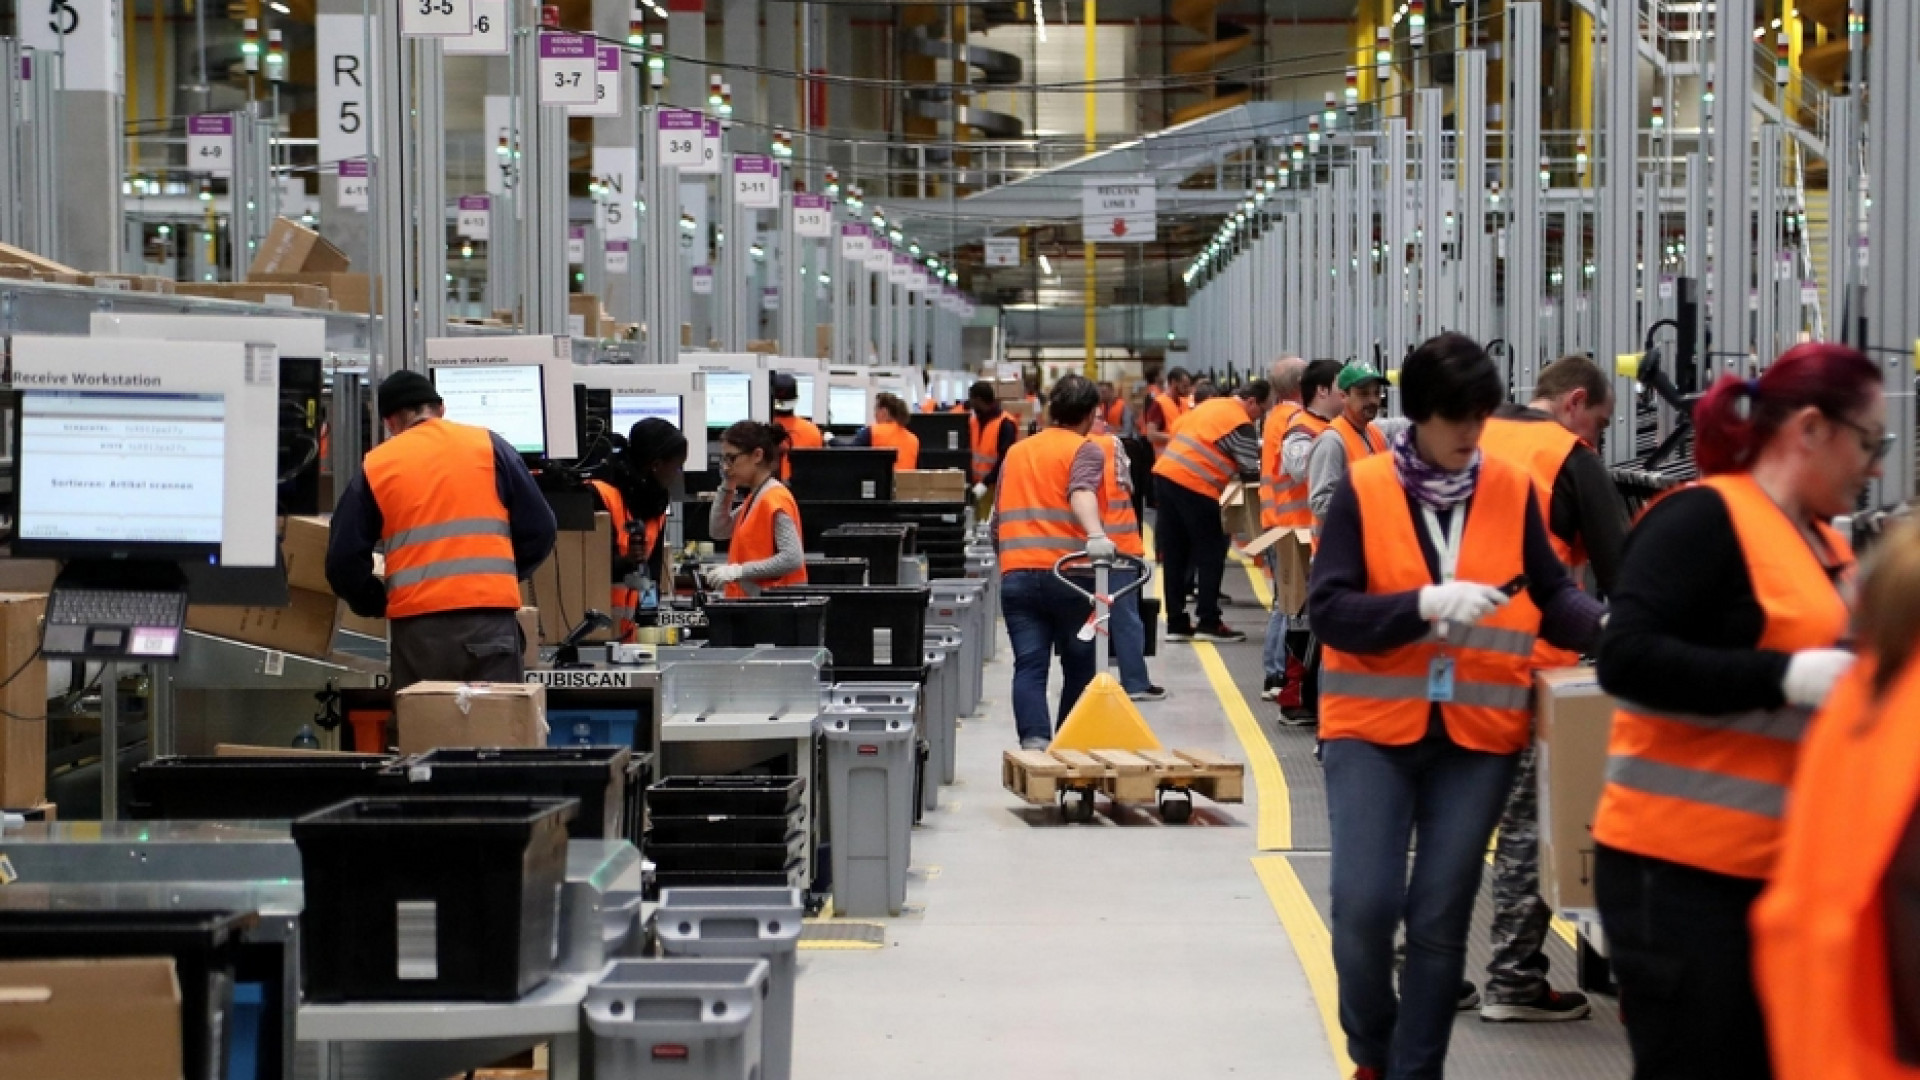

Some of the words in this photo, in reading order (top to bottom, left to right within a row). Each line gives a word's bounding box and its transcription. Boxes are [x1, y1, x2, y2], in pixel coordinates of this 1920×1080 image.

[334, 55, 363, 87] R
[554, 72, 583, 87] 3-7
[340, 102, 361, 133] 5
[670, 139, 692, 153] 3-9
[740, 182, 765, 192] 3-11
[607, 203, 622, 224] 5
[13, 371, 68, 385] Receive
[72, 371, 162, 388] Workstation
[525, 672, 627, 687] CUBISCAN
